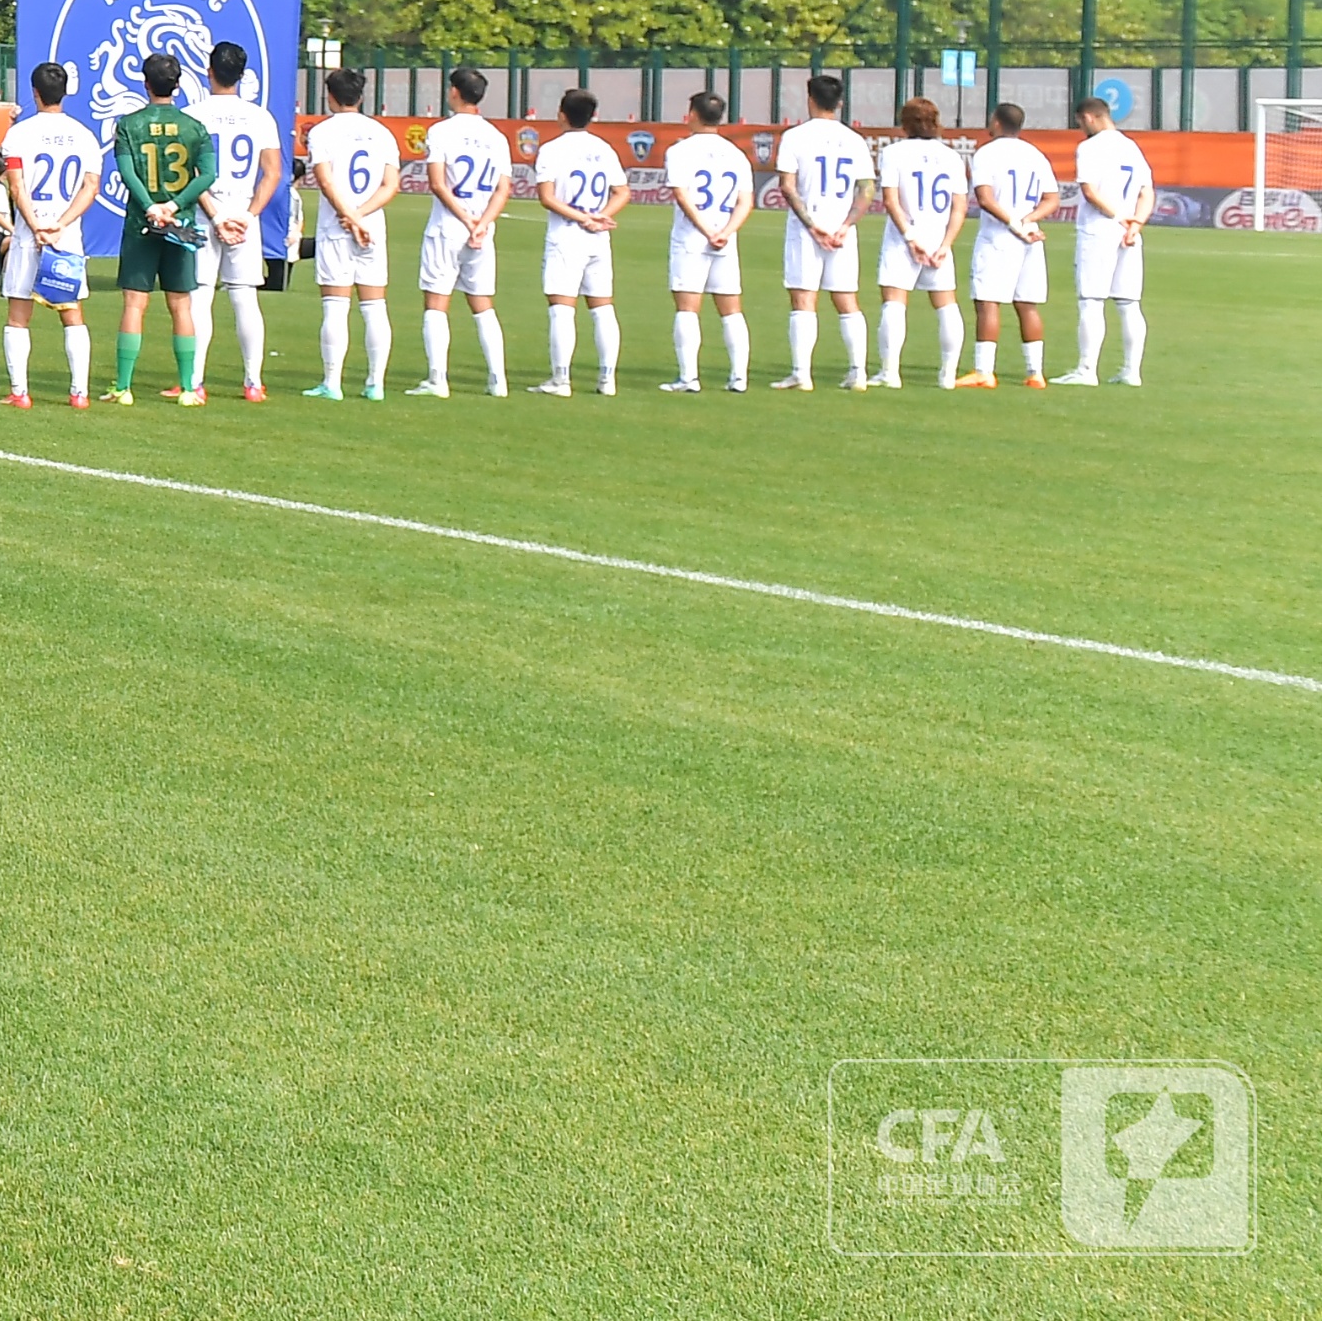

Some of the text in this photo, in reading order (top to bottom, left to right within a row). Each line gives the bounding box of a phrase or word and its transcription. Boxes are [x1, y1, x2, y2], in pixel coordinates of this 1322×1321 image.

[31, 153, 81, 202] 20
[141, 142, 189, 192] 13
[349, 150, 370, 194] 6
[452, 155, 495, 198] 24
[815, 156, 853, 198] 15
[1120, 165, 1133, 200] 7
[568, 170, 606, 213] 29
[695, 170, 738, 213] 32
[912, 171, 950, 213] 16
[1008, 169, 1040, 209] 14
